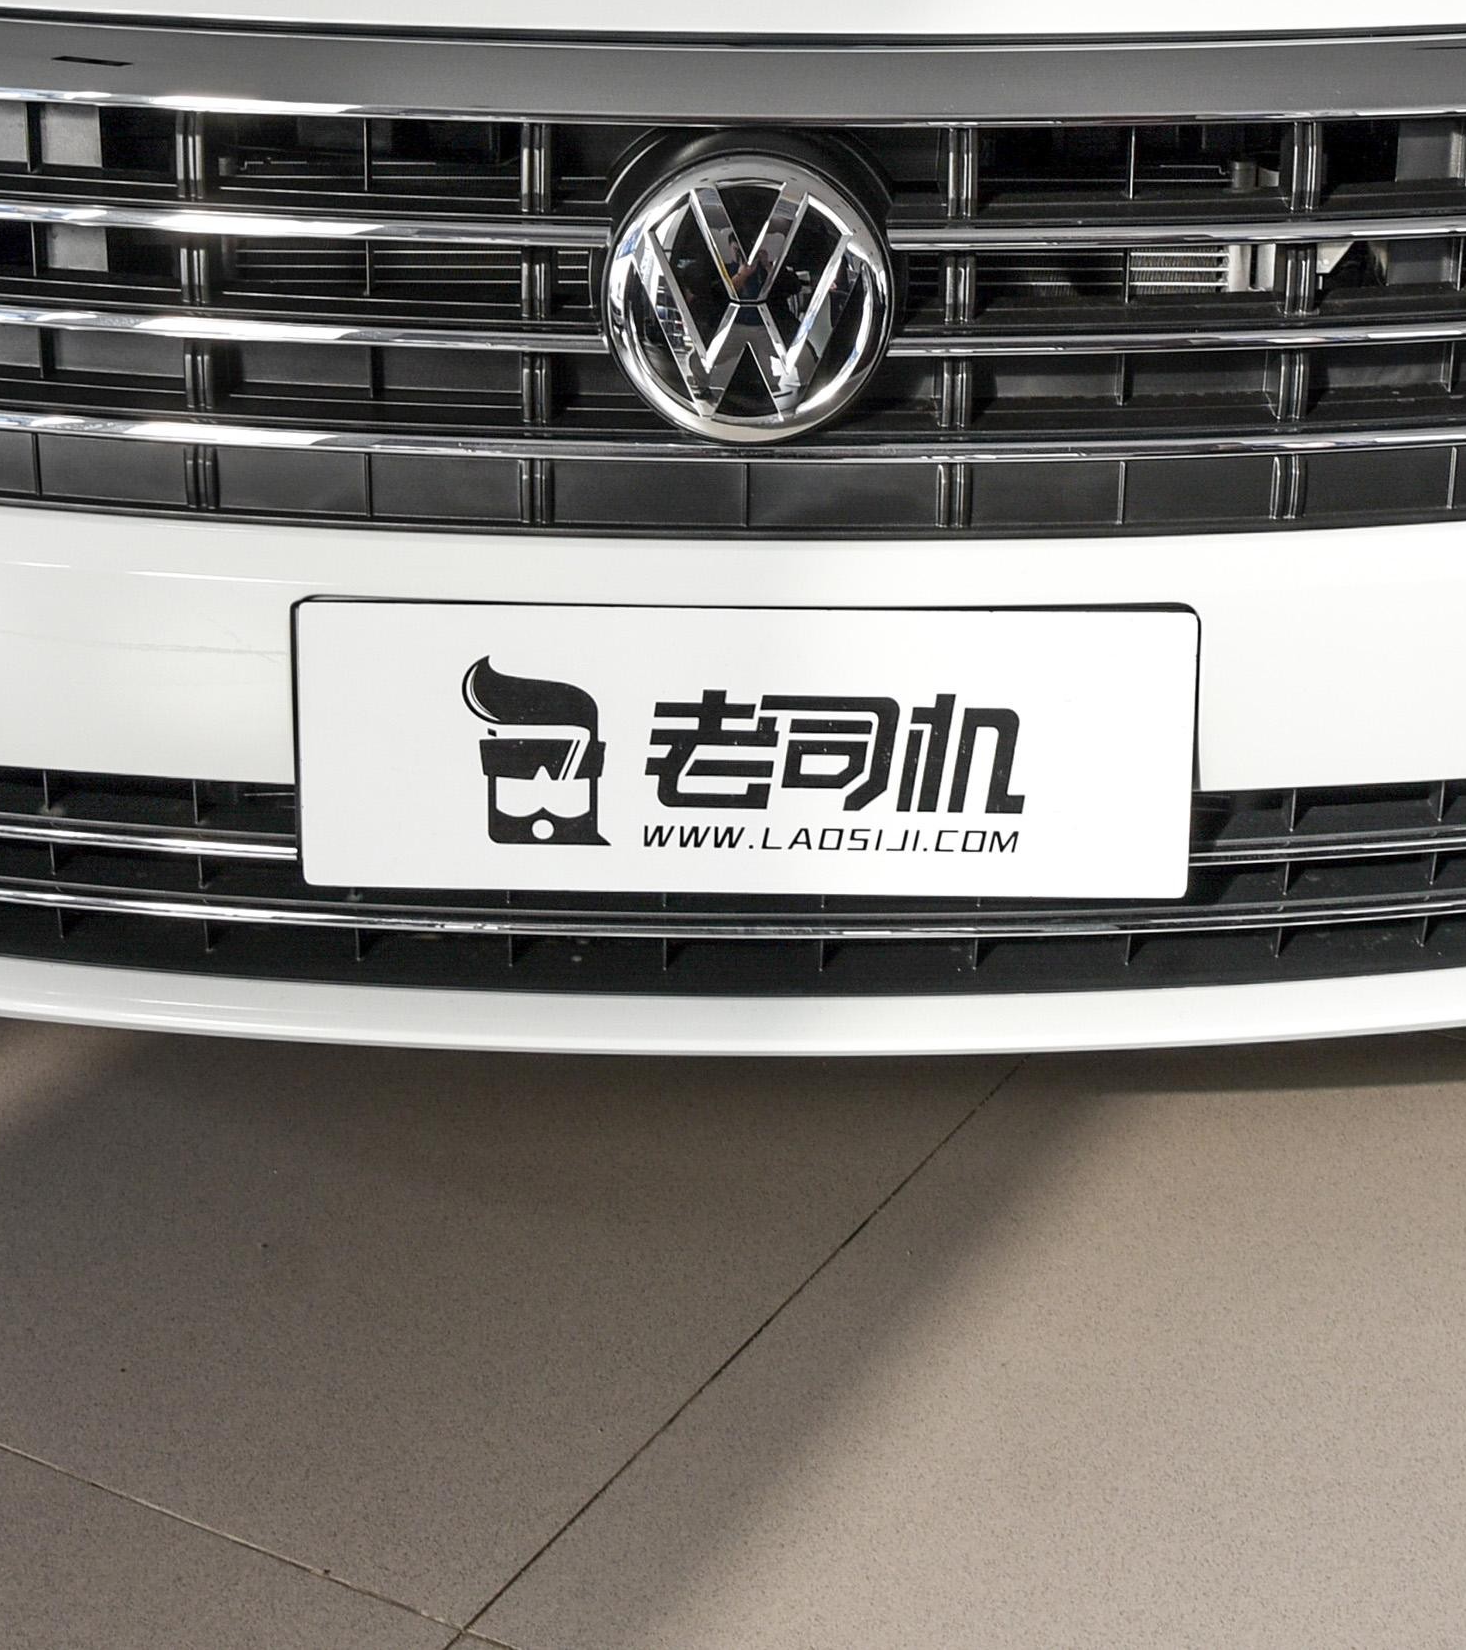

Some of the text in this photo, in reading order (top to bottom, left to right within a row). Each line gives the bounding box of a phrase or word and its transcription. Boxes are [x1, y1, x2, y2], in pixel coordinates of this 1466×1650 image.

[646, 690, 1025, 814] 老司机
[642, 824, 1019, 854] WWW.LAOSIJI.COM
